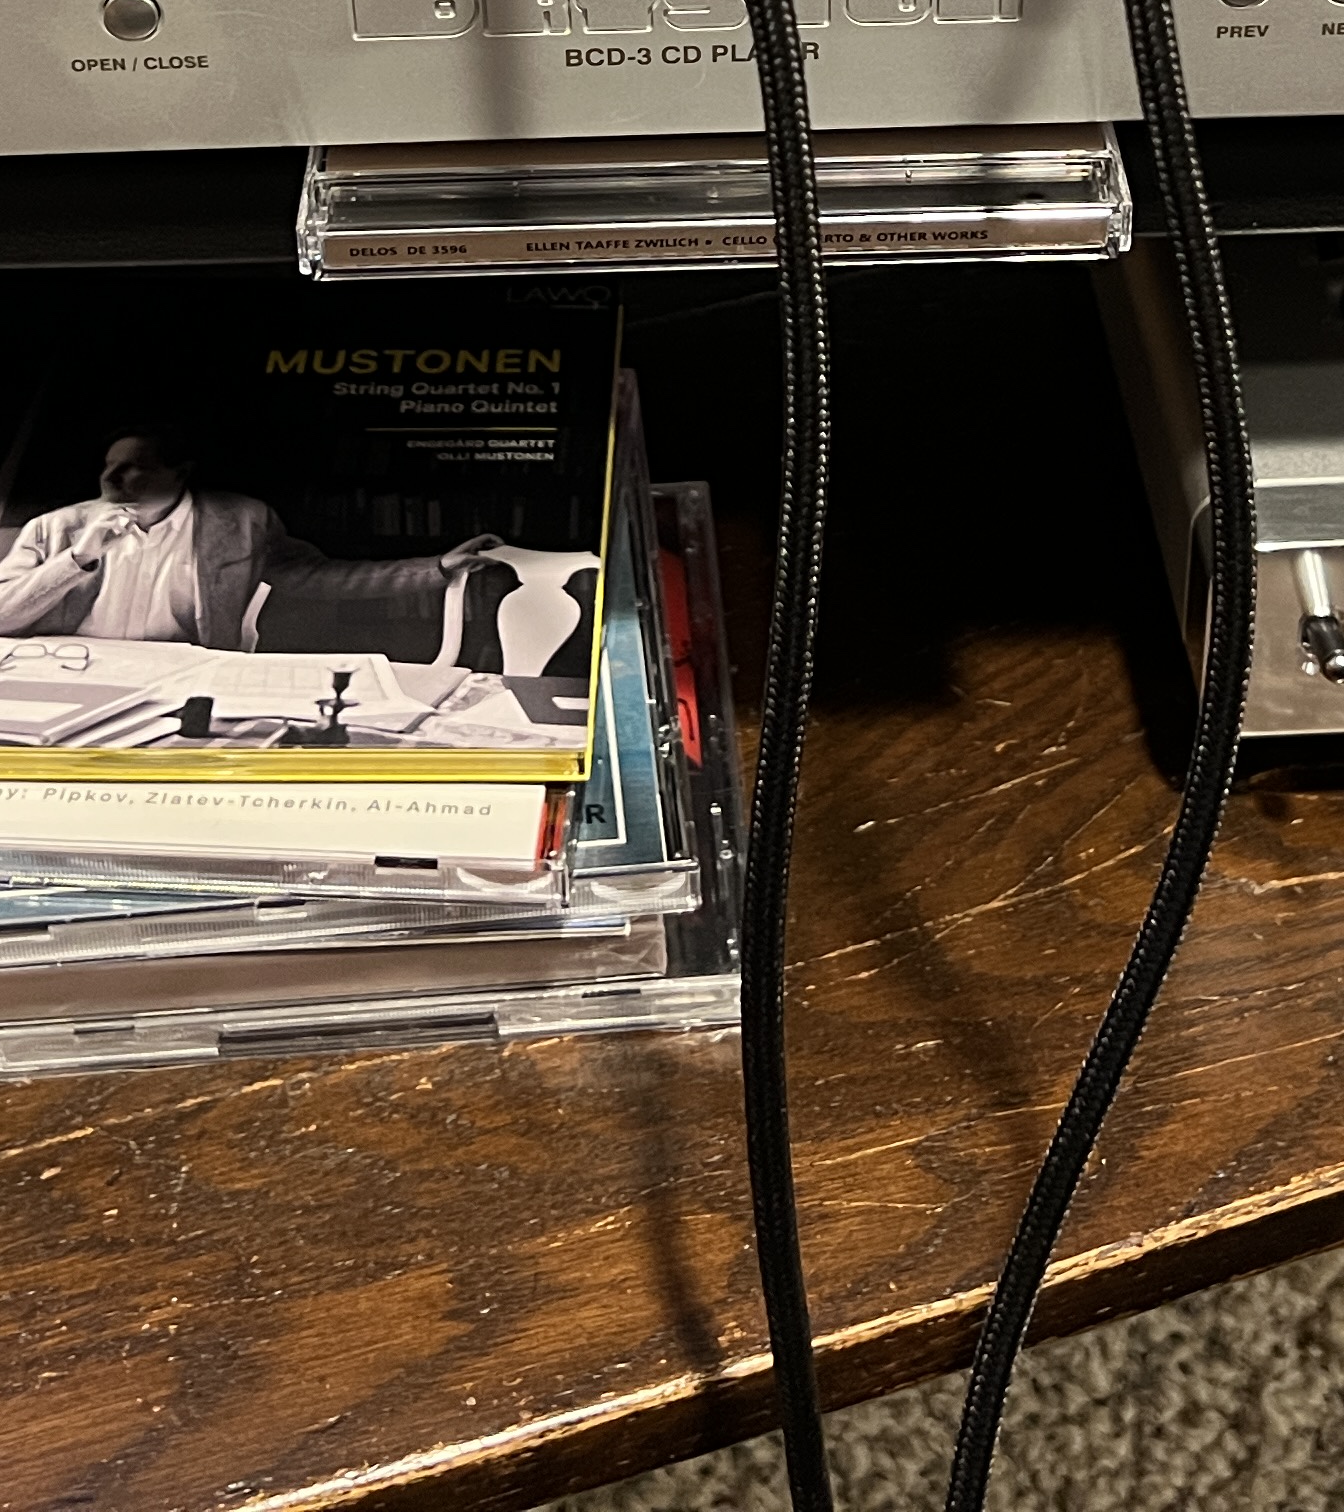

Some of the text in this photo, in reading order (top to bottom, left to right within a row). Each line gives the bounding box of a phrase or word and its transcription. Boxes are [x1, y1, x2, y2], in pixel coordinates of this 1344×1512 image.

[1216, 25, 1270, 39] PREV
[71, 57, 126, 73] OPEN
[143, 54, 209, 70] CLOSE
[565, 47, 652, 67] BCD-3
[661, 45, 702, 65] CD
[526, 240, 571, 252] ELLEN
[575, 238, 630, 251] TAAFFE
[634, 237, 700, 249] ZWILICH
[722, 235, 768, 246] CELLO
[859, 233, 872, 243] &
[876, 231, 929, 243] OTHER
[932, 229, 989, 242] WORKS
[349, 244, 468, 257] DELOS DE 3596
[265, 349, 561, 375] MUSTONEN
[333, 382, 561, 398] String Quartet No. 1
[399, 399, 559, 414] Piano Quintet
[366, 799, 493, 817] Al-Ahmad
